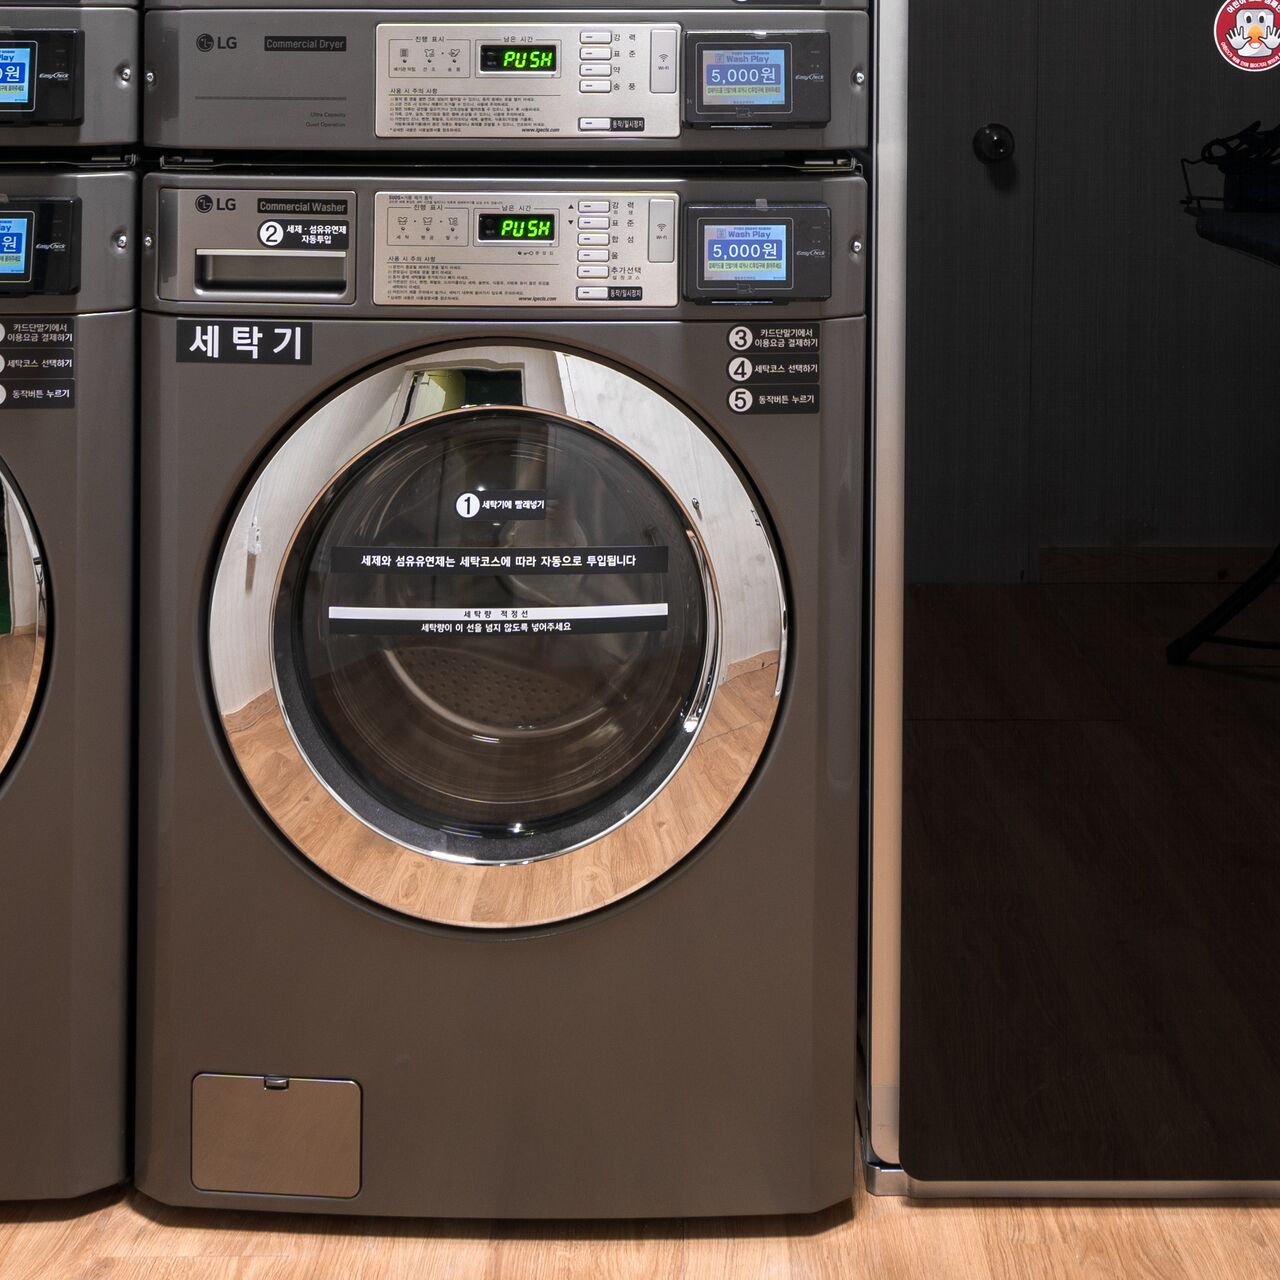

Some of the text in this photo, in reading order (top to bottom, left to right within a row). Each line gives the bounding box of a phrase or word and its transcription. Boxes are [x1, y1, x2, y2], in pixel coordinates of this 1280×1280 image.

[266, 39, 345, 50] Commercial Dryer
[503, 51, 553, 68] PUSH
[726, 55, 769, 64] Wash Play
[711, 68, 776, 84] 5,000원
[260, 201, 346, 212] Commercial Washer
[501, 220, 551, 237] PUSH
[728, 230, 771, 239] Wash Play
[712, 243, 777, 260] 5,000원
[189, 325, 301, 360] 세탁기
[482, 499, 512, 510] 세탁기에
[515, 499, 545, 509] 빨래넣기
[361, 555, 636, 568] 세제와 섬유유연제는 세탁코스에 따라 자동으로 투입됩니다
[421, 621, 572, 633] 세탁량이 이 선을 넘지 않도록 넣어주세요
